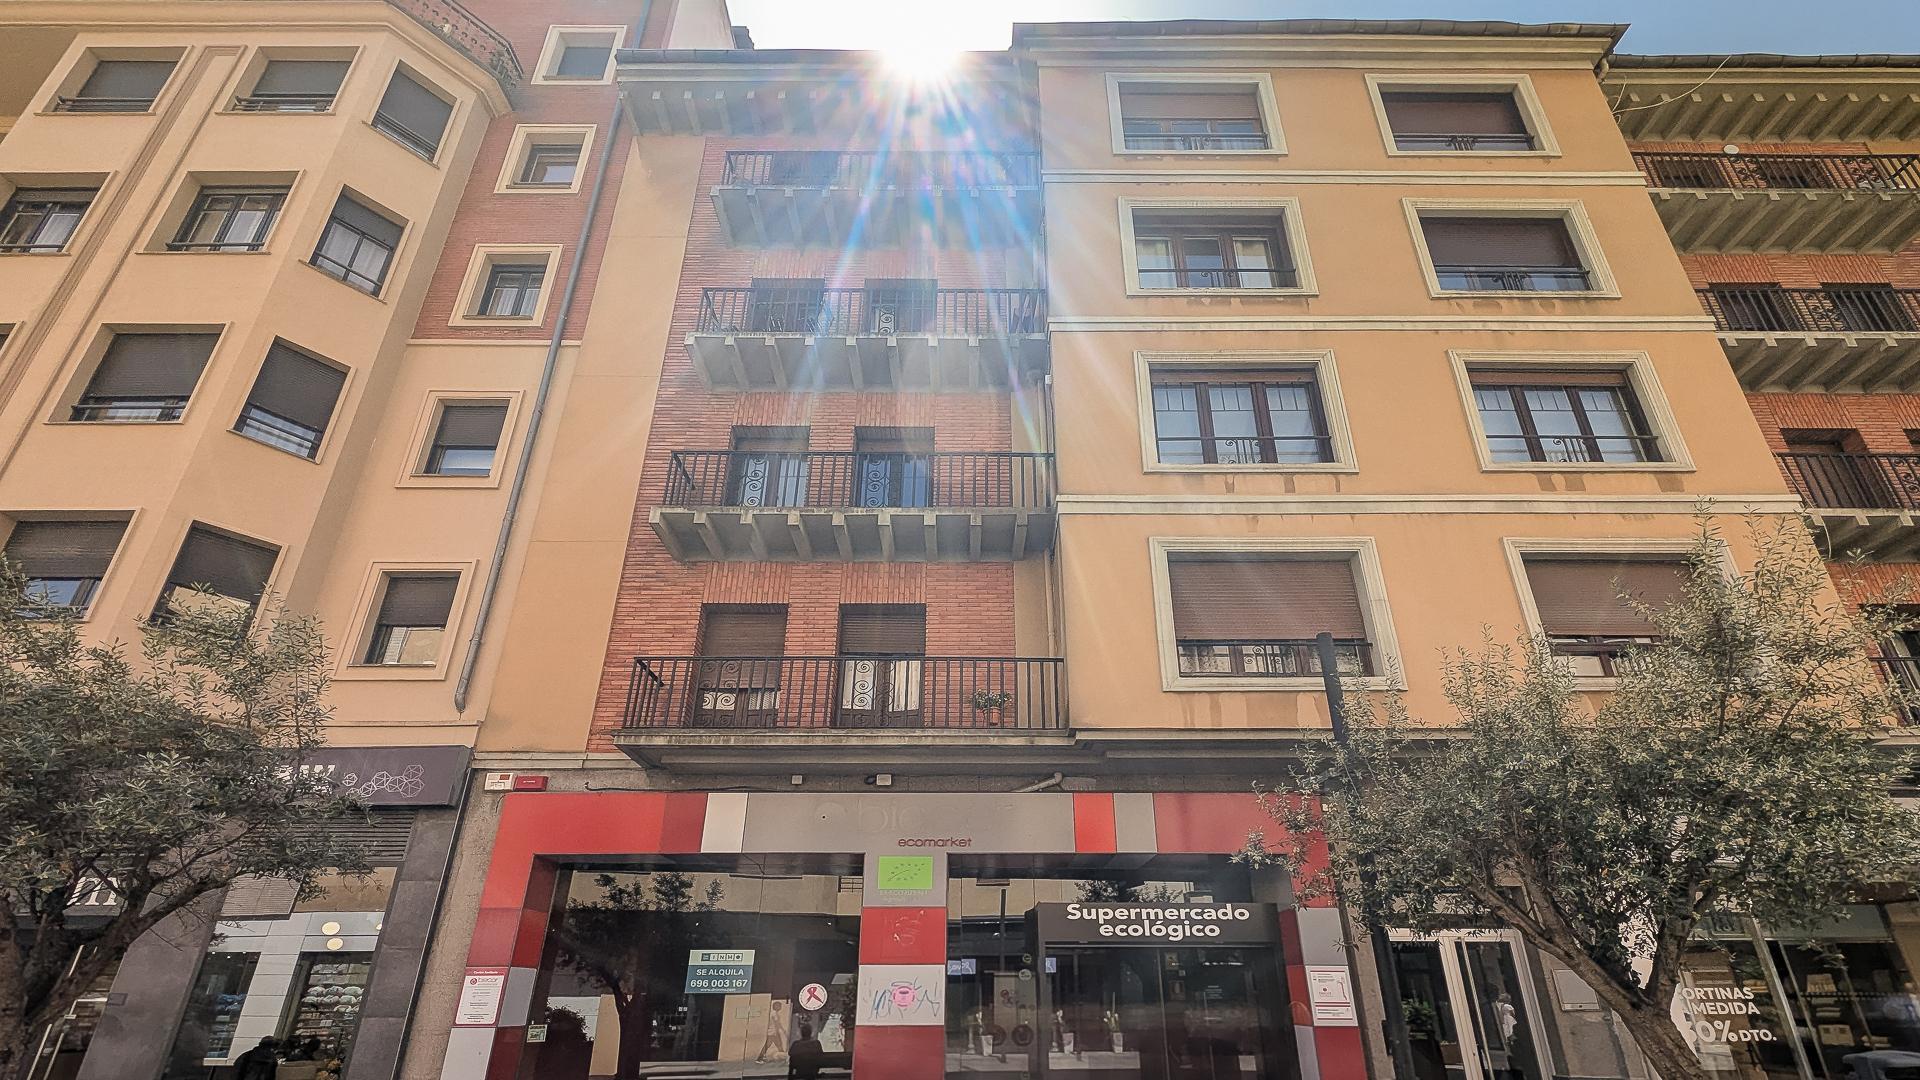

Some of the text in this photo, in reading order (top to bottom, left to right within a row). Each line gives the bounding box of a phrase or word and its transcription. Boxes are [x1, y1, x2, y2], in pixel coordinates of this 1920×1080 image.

[898, 837, 972, 847] ecomarket
[1066, 903, 1250, 923] Supermercado
[1099, 920, 1221, 941] ecológico
[708, 969, 744, 977] ALQUILA
[690, 979, 748, 988] 696 003 167
[1680, 986, 1755, 1000] ORTINAS
[1691, 1001, 1761, 1015] MEDIDA
[1738, 1029, 1778, 1042] DTO.
